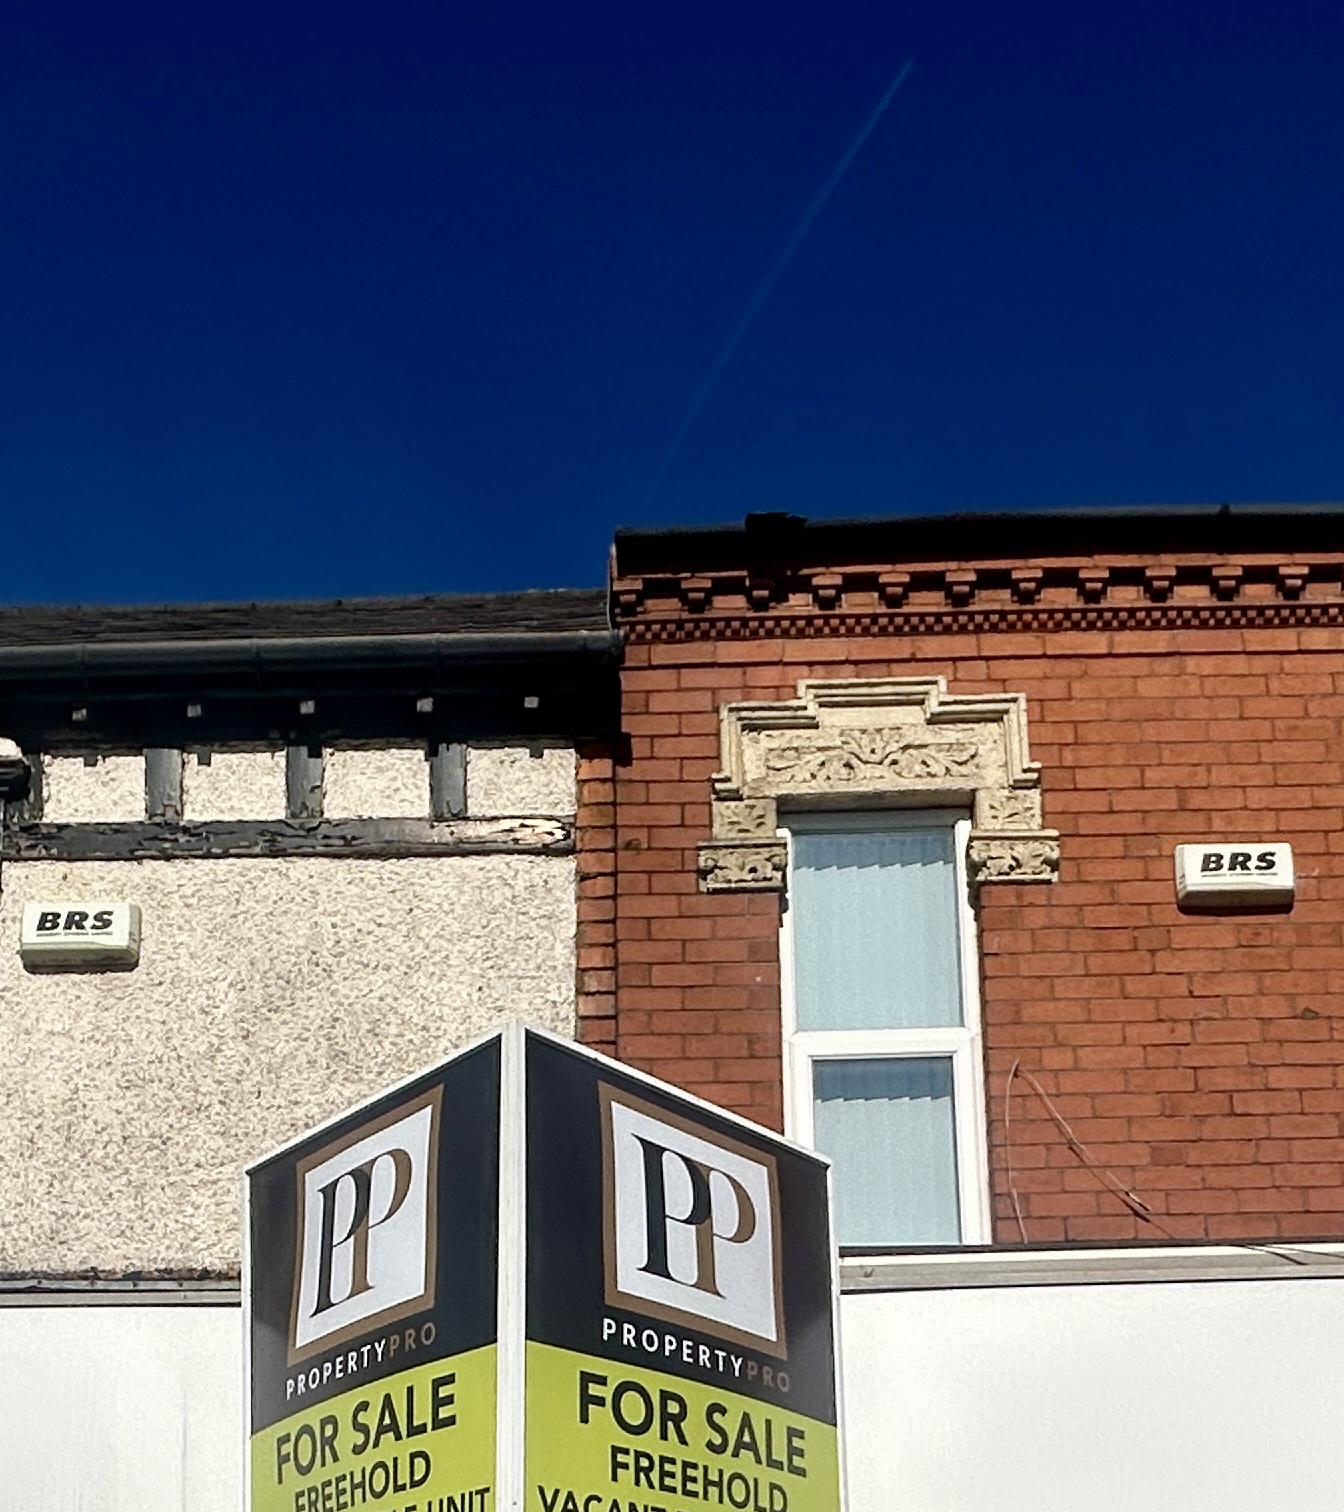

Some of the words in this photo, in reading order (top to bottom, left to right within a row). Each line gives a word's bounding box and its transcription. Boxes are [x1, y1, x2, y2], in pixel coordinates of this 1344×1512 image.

[1201, 851, 1276, 872] BRS
[36, 910, 114, 931] BRS
[276, 1414, 339, 1485] FOR
[351, 1373, 457, 1455] SALE
[579, 1371, 688, 1445] FOR
[705, 1402, 807, 1478] SALE
